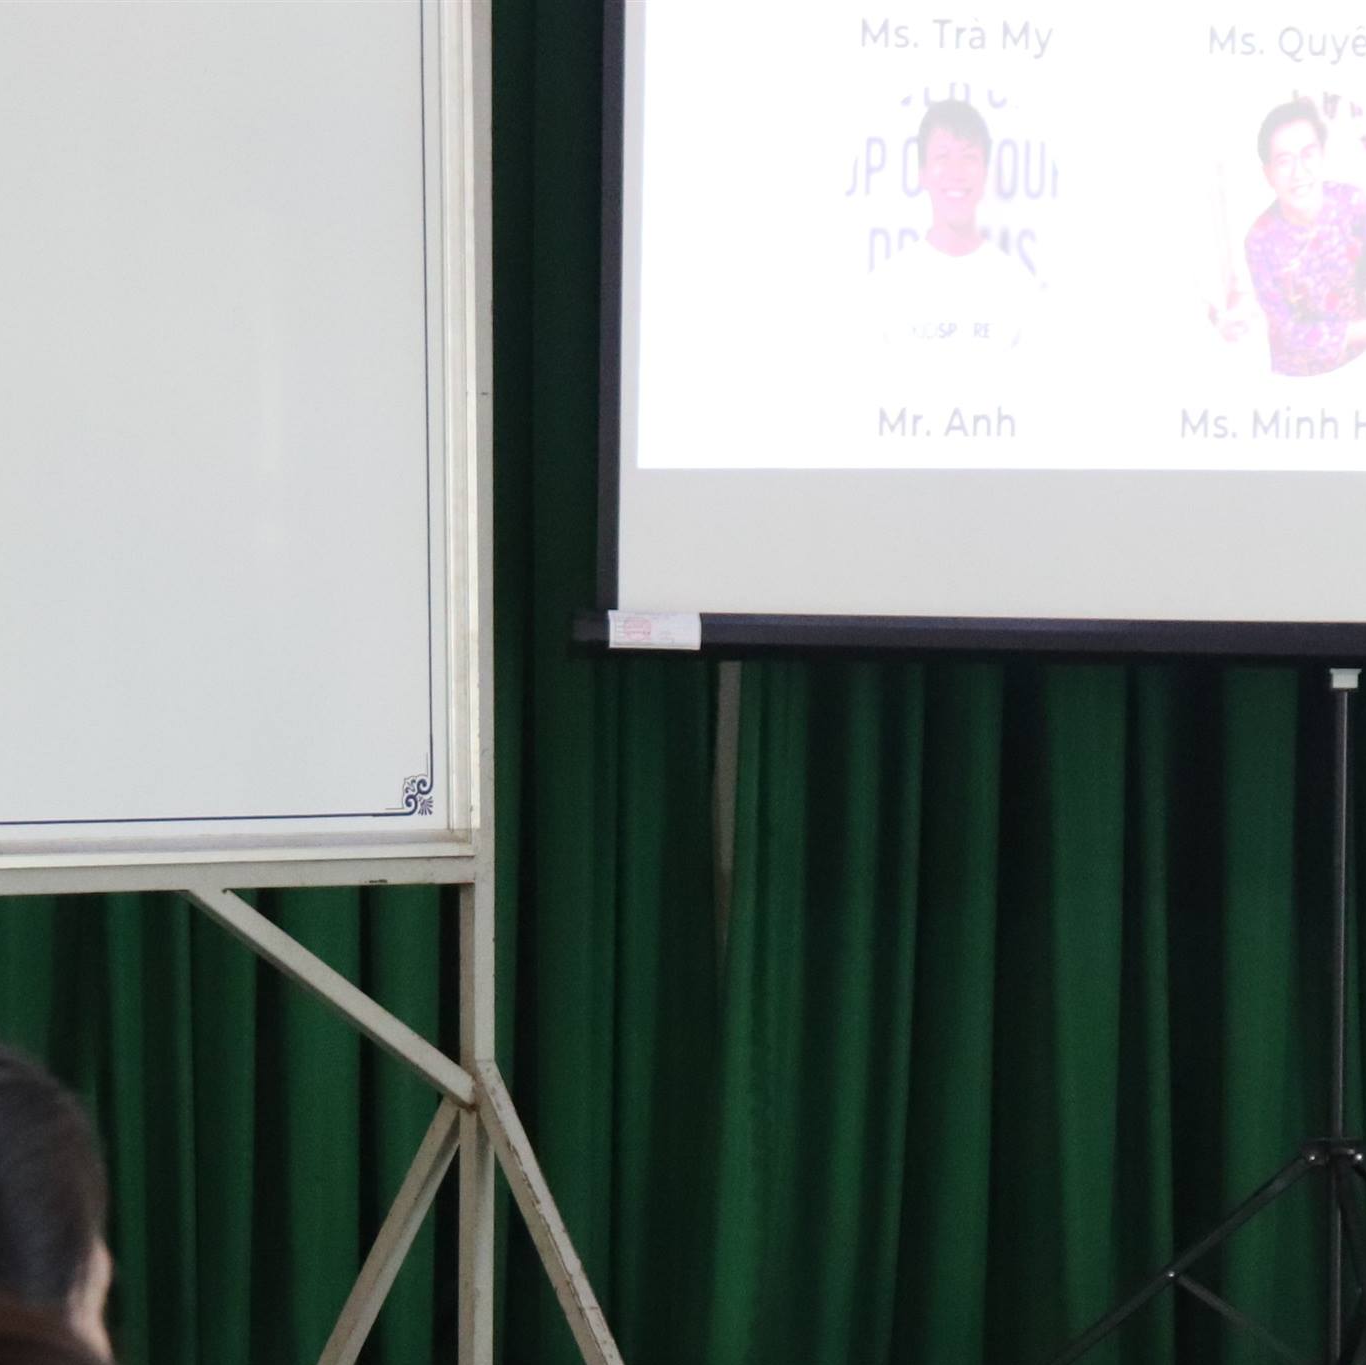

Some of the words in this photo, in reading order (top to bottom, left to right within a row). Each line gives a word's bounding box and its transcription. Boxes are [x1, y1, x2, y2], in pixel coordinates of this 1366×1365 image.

[861, 17, 919, 49] Ms.
[932, 17, 985, 50] Trà
[1002, 20, 1054, 59] My
[1209, 24, 1265, 56] Ms.
[878, 406, 931, 437] Mr.
[943, 405, 1017, 437] Anh
[1180, 408, 1238, 439] Ms.
[1252, 405, 1339, 440] Minh
